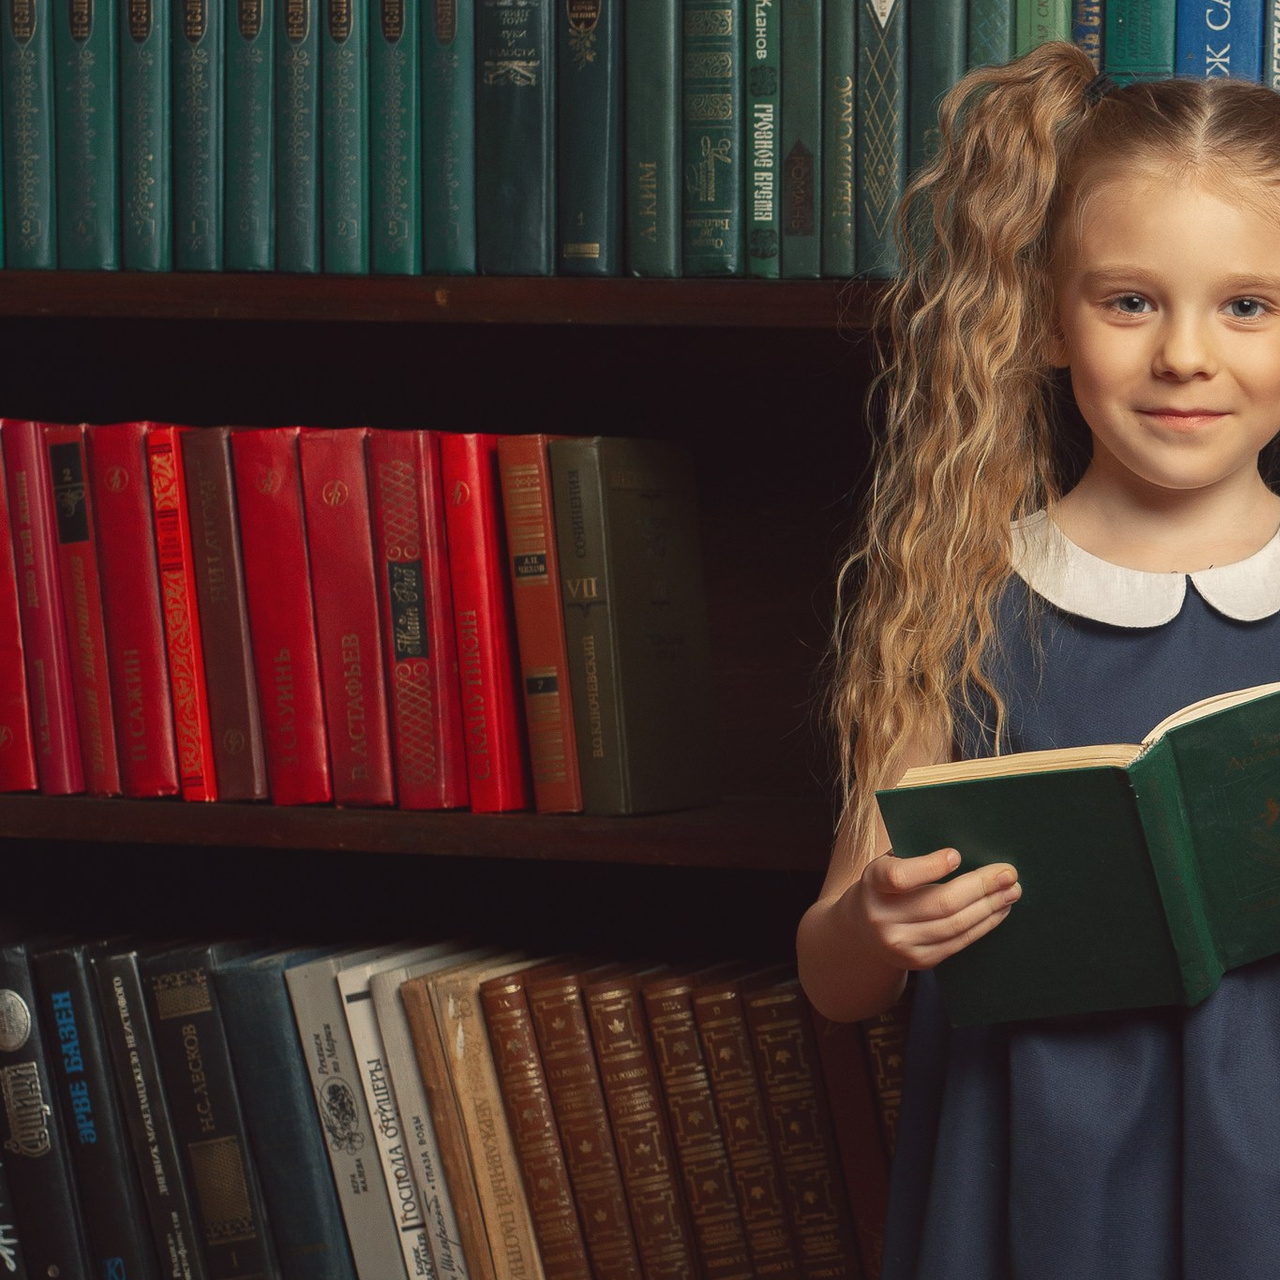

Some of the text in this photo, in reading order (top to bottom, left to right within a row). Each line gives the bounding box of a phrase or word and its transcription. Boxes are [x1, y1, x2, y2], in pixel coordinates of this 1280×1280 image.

[753, 102, 774, 169] ГРОЗНОЕ
[639, 161, 657, 216] КИМ
[388, 221, 399, 235] 5
[62, 469, 72, 481] 2
[569, 471, 588, 558] СОЧИНЕНИЯ
[565, 576, 599, 600] VII
[341, 633, 367, 758] АСТАФЬЕВ
[51, 990, 98, 1145] ЭРВЕ БАЗЕН
[367, 1058, 420, 1223] ГОСПОДА ОФИЦЕРЫ
[412, 1115, 435, 1185] ГЛАЗА ВОДЫ
[472, 1096, 517, 1204] ДЕРЖАВНЫЙ
